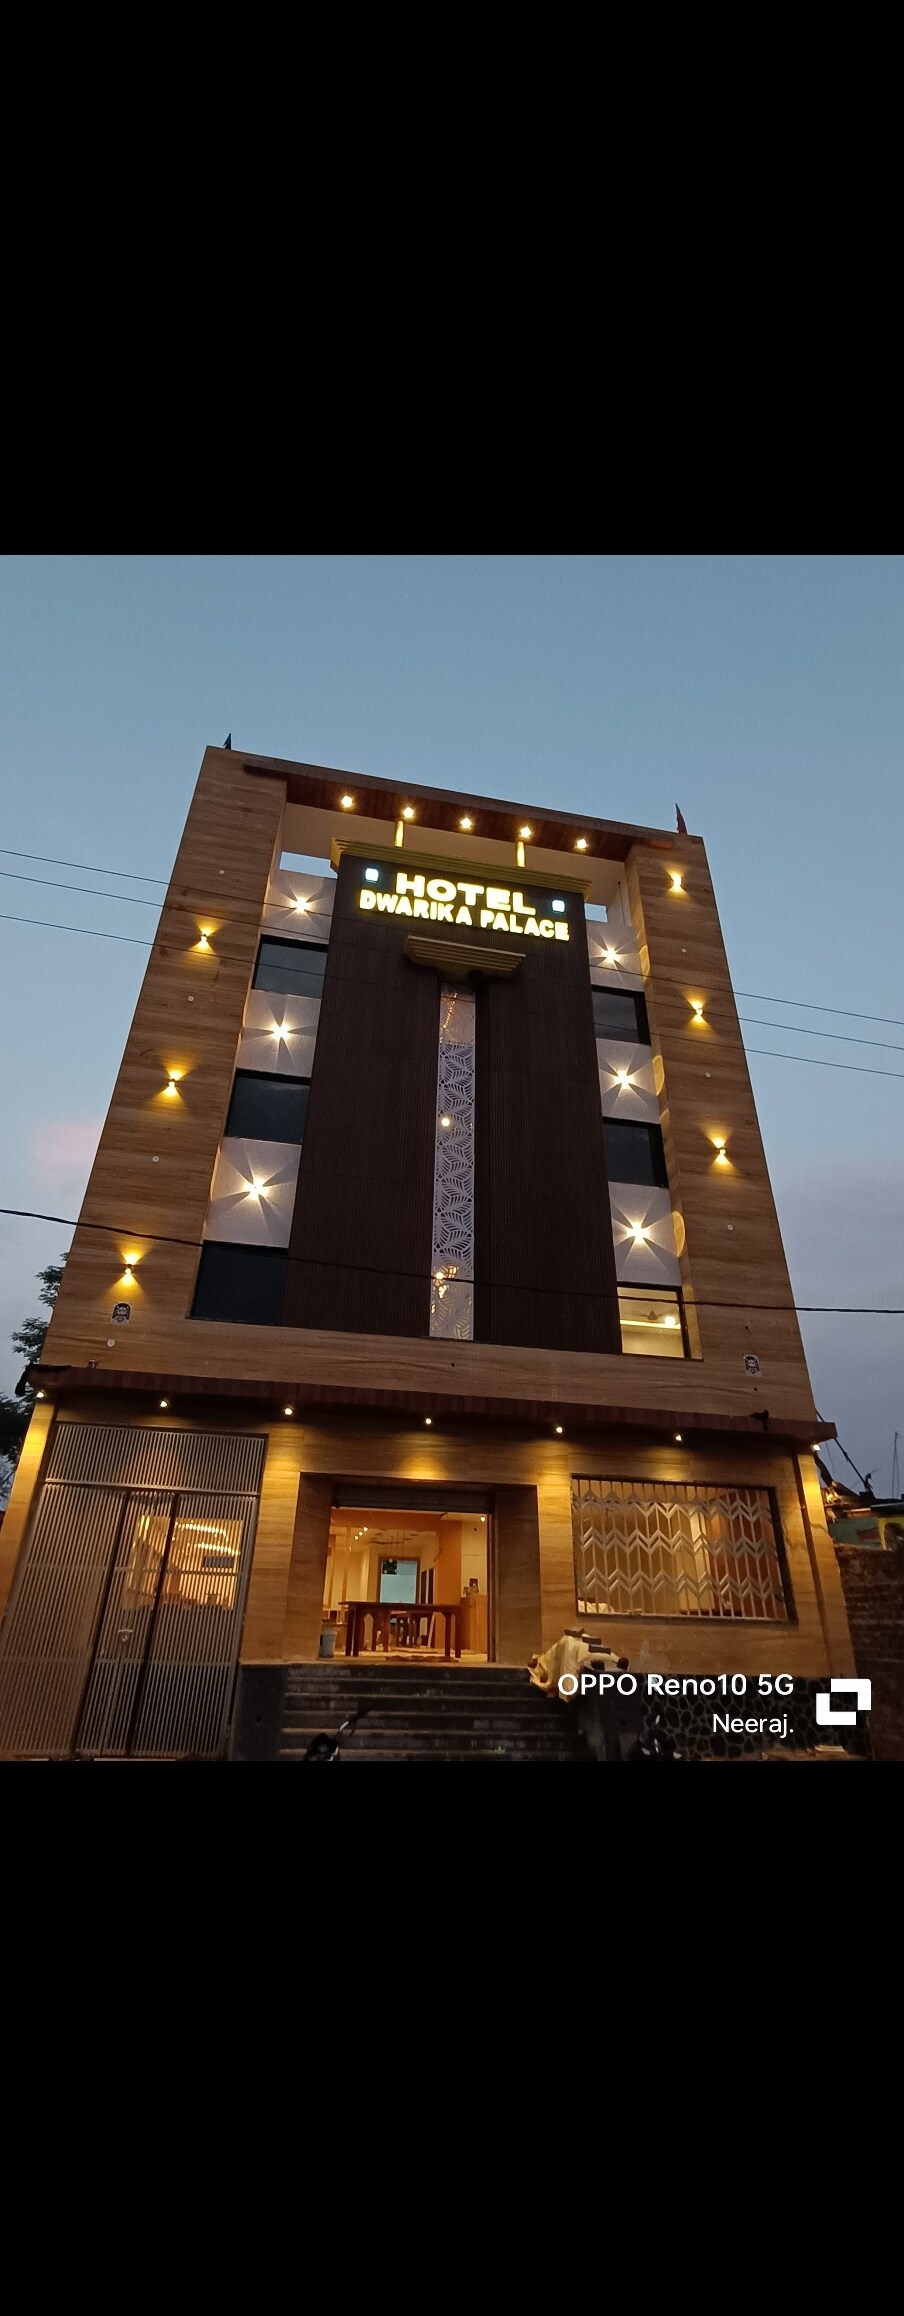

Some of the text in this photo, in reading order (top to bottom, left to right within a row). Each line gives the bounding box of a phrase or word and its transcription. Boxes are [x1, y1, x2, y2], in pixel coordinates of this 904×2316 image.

[359, 889, 570, 941] DWARIKA PALACE
[395, 872, 536, 916] HOTEL
